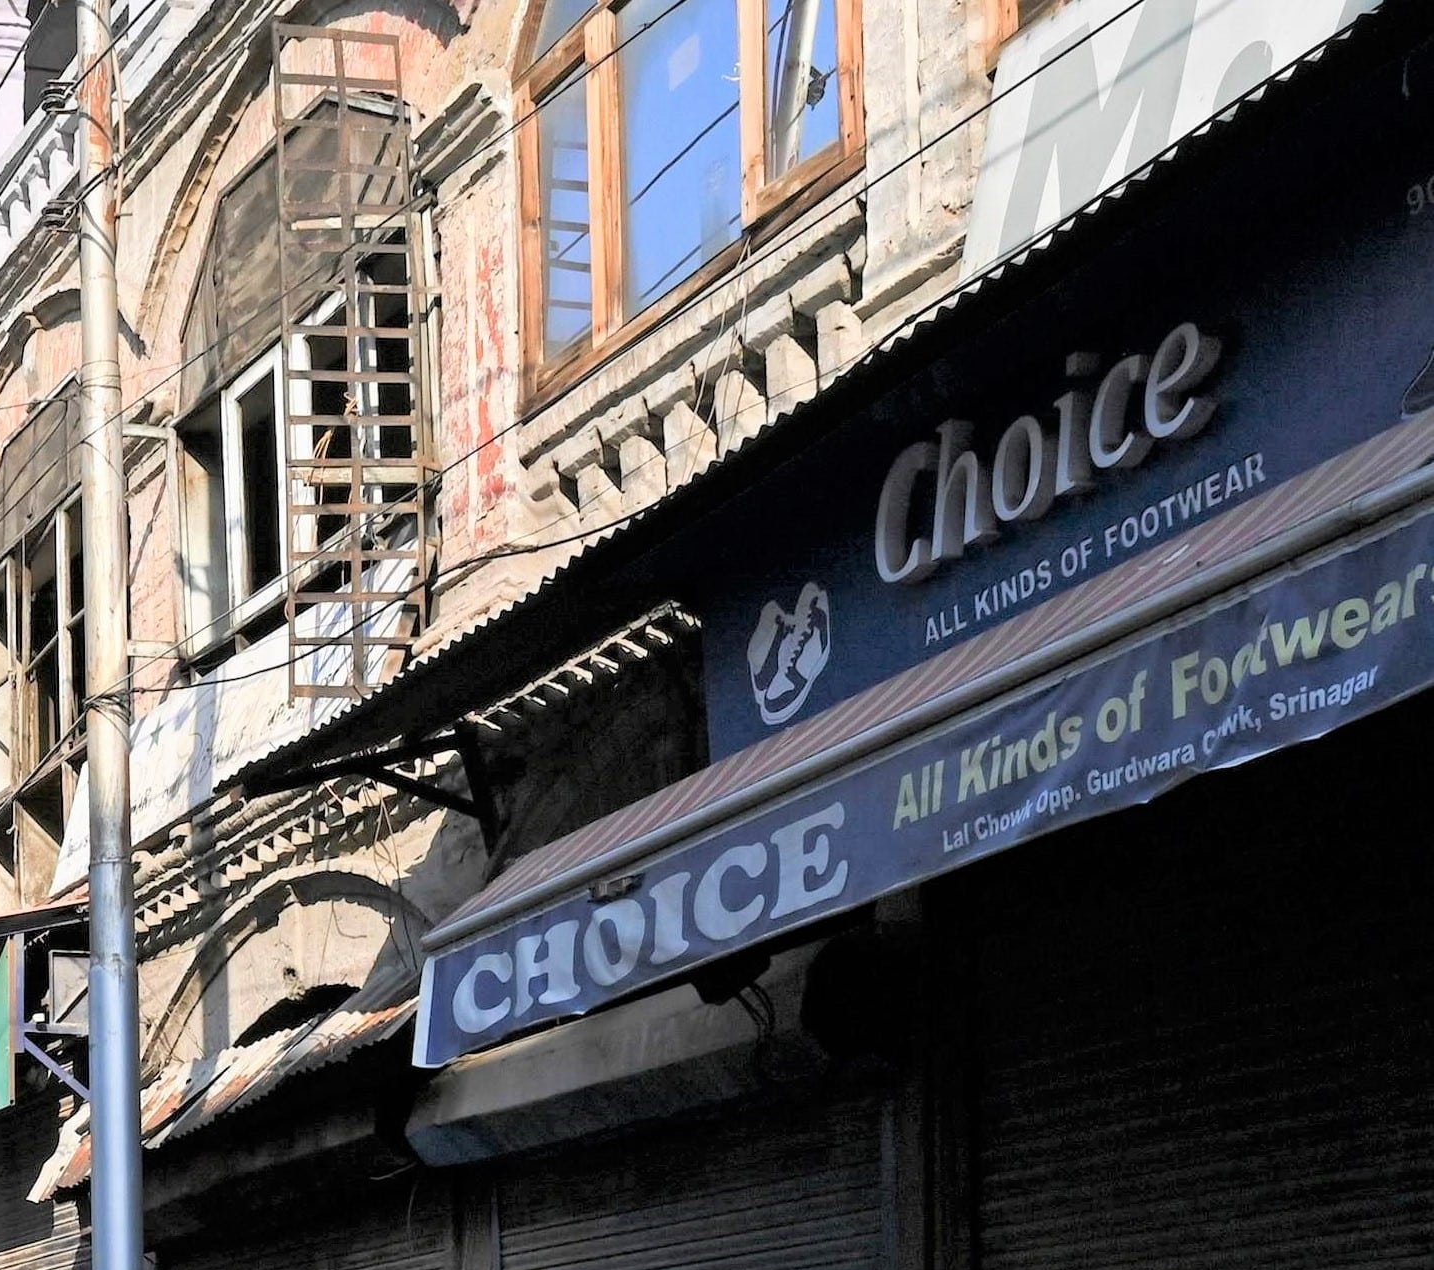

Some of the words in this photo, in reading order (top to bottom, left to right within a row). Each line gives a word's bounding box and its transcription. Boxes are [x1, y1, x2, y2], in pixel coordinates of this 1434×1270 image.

[874, 322, 1223, 586] Choice
[925, 603, 967, 646] ALL
[974, 559, 1053, 621] KINDS
[1059, 538, 1094, 580] OF
[1104, 452, 1267, 558] FOOTWEAR
[892, 758, 943, 831] All
[956, 709, 1083, 803] Kinds
[1095, 668, 1147, 744] of
[1170, 562, 1434, 720] Footwear
[942, 817, 969, 852] Lal
[1035, 783, 1081, 817] Opp.
[1085, 744, 1196, 797] Gurdwara
[1269, 664, 1379, 723] Srinagar
[452, 801, 849, 1034] CHOICE
